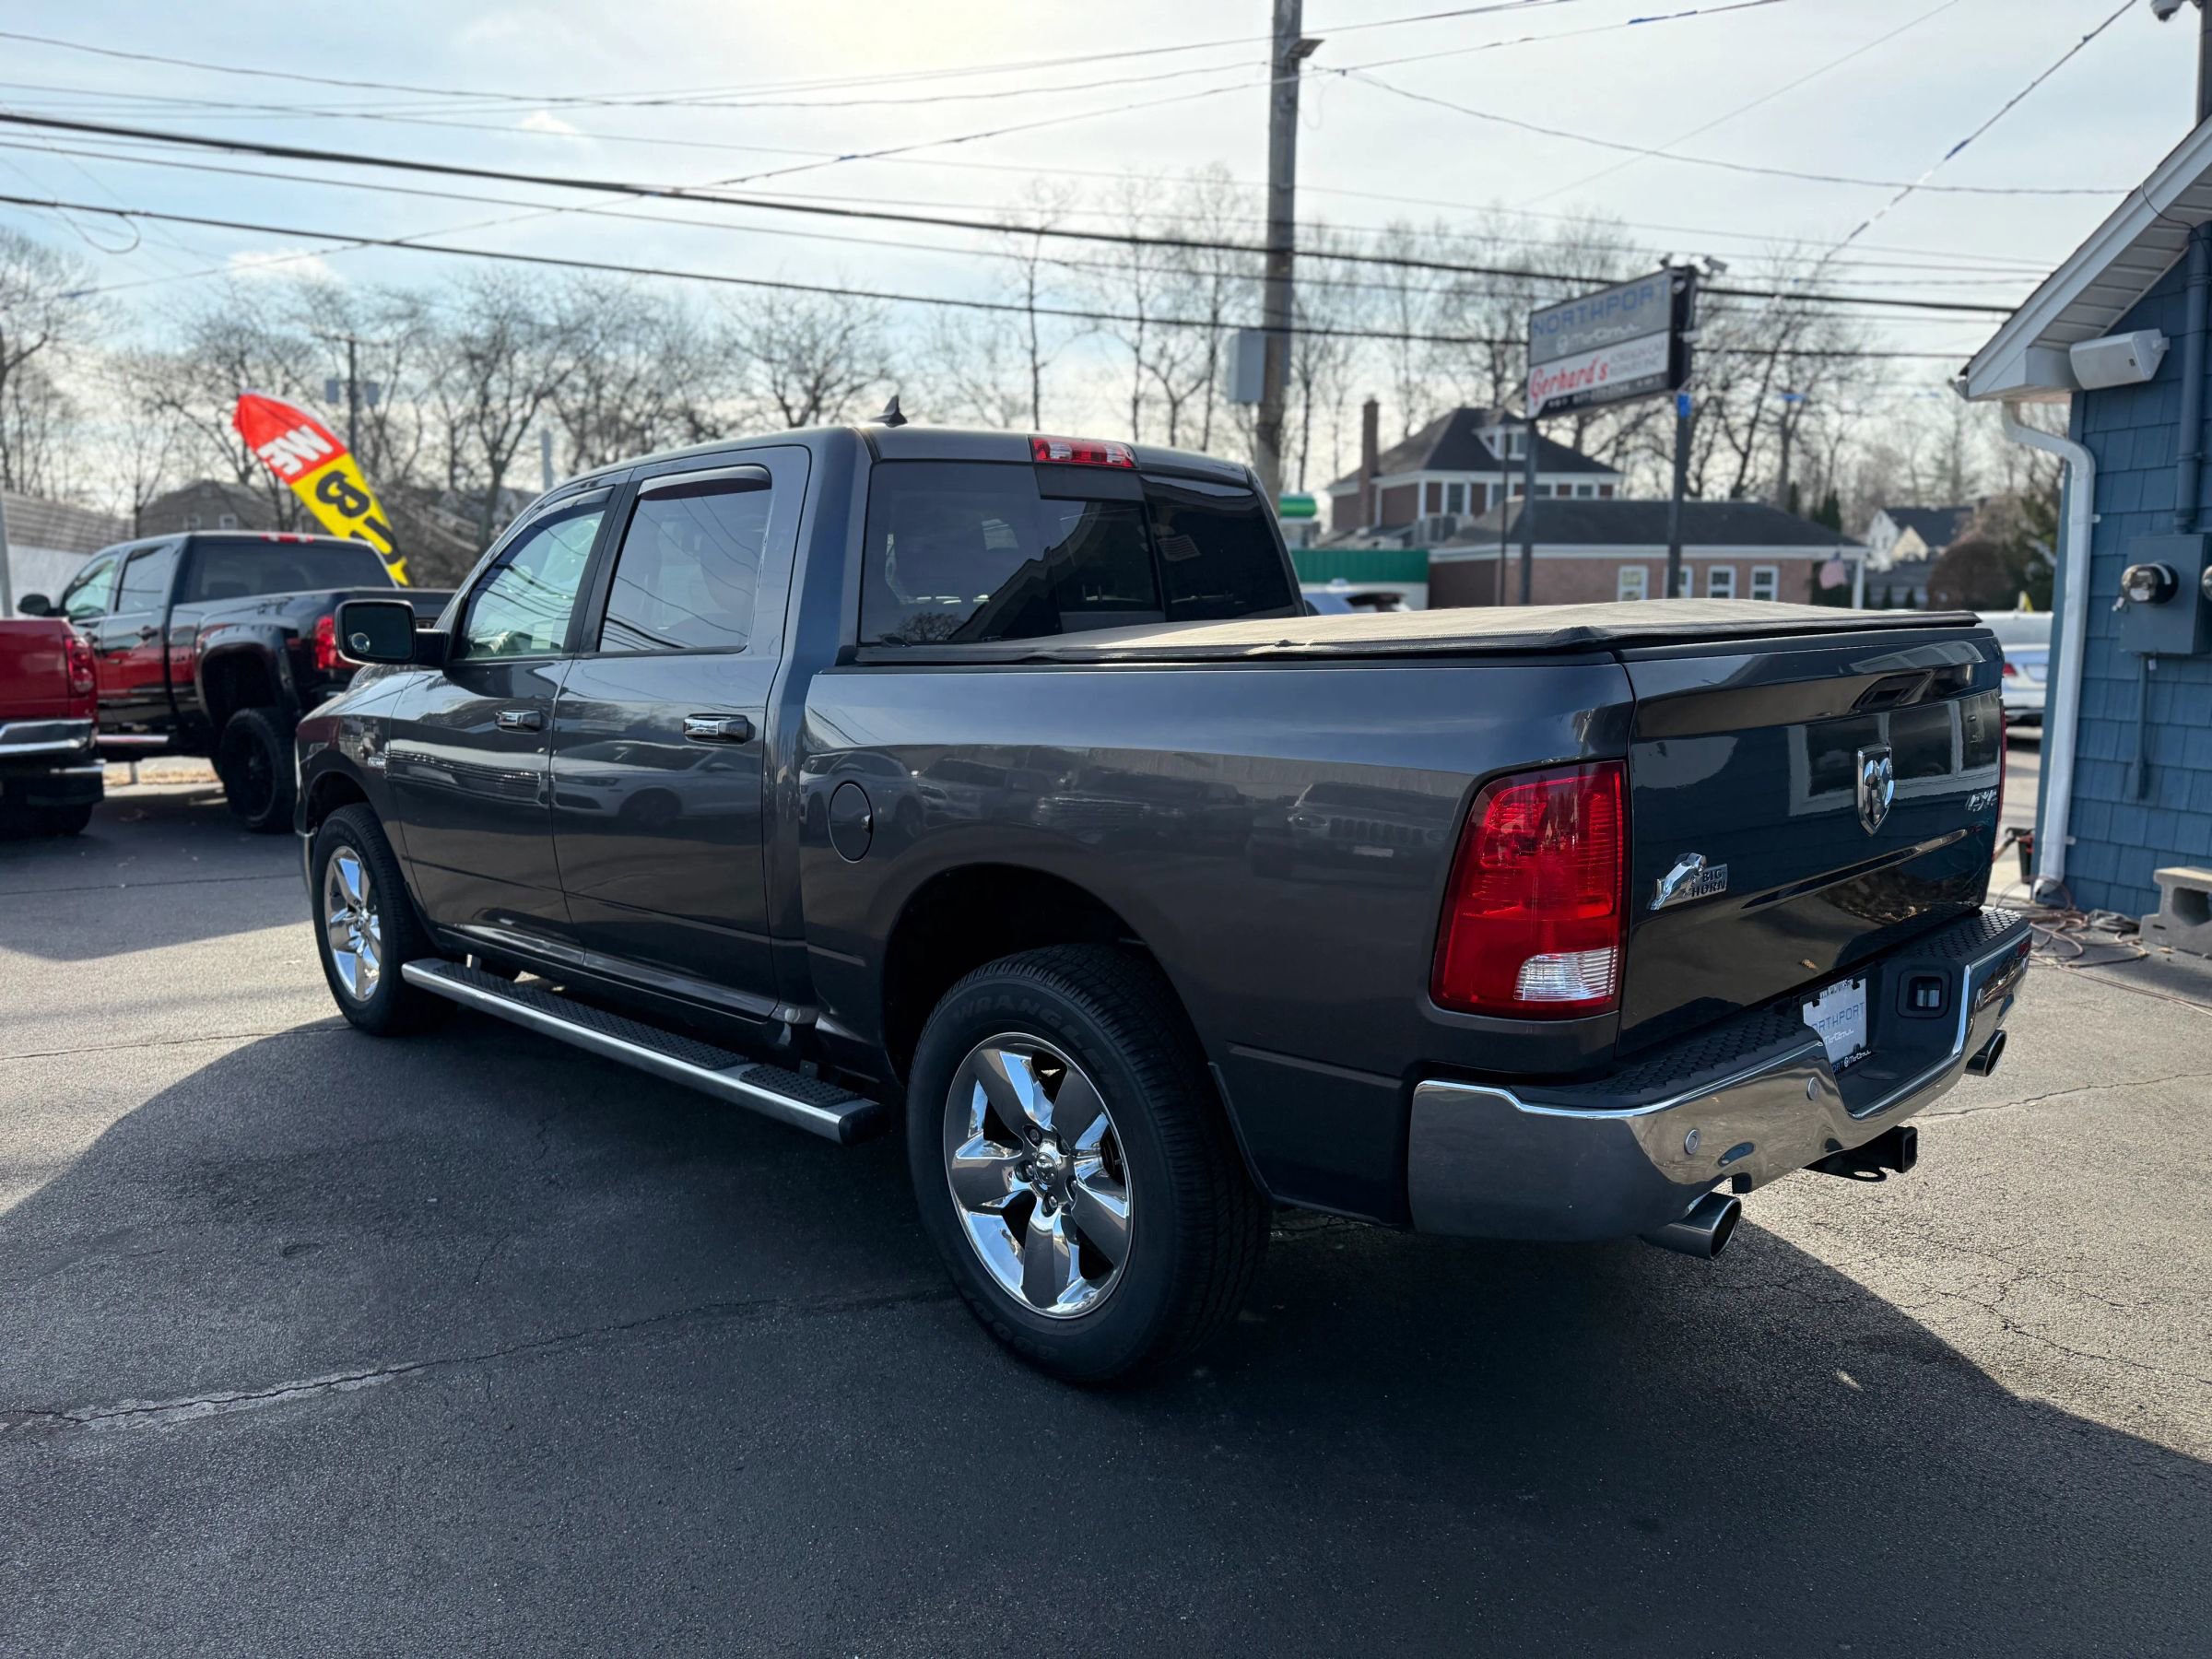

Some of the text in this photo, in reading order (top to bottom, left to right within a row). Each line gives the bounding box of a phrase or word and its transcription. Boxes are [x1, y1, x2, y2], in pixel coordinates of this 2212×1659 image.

[1534, 281, 1667, 335] NORTHPORT
[1530, 354, 1608, 407] Gerhard's
[1691, 880, 1726, 898] HORN
[1702, 869, 1723, 883] BIG
